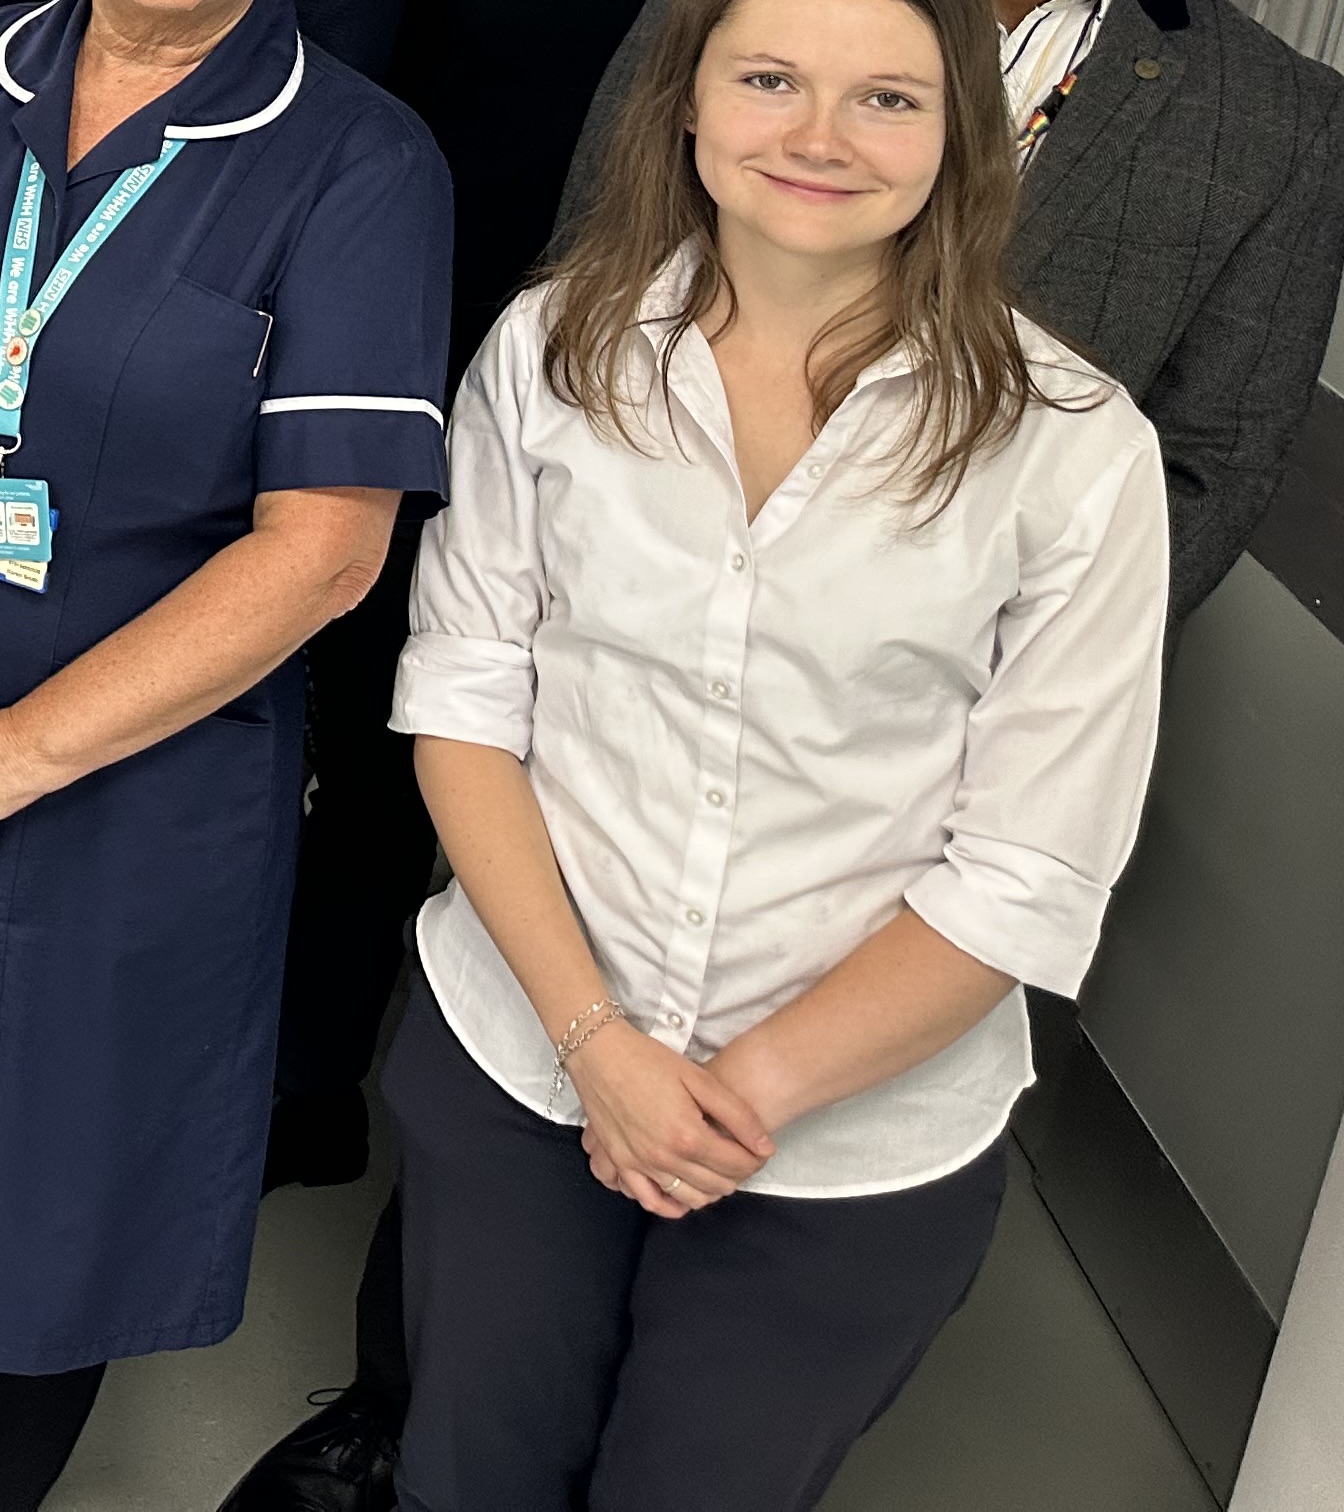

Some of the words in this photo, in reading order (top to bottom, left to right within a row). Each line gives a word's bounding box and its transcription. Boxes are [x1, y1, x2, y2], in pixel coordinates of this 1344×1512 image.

[27, 161, 40, 183] are
[20, 184, 38, 217] WHH
[14, 219, 31, 248] NHS
[47, 269, 70, 300] NHS
[68, 243, 90, 264] We
[86, 222, 106, 243] are
[100, 190, 131, 221] WHH
[124, 165, 154, 192] NHS
[9, 257, 26, 278] We
[6, 280, 19, 304] are
